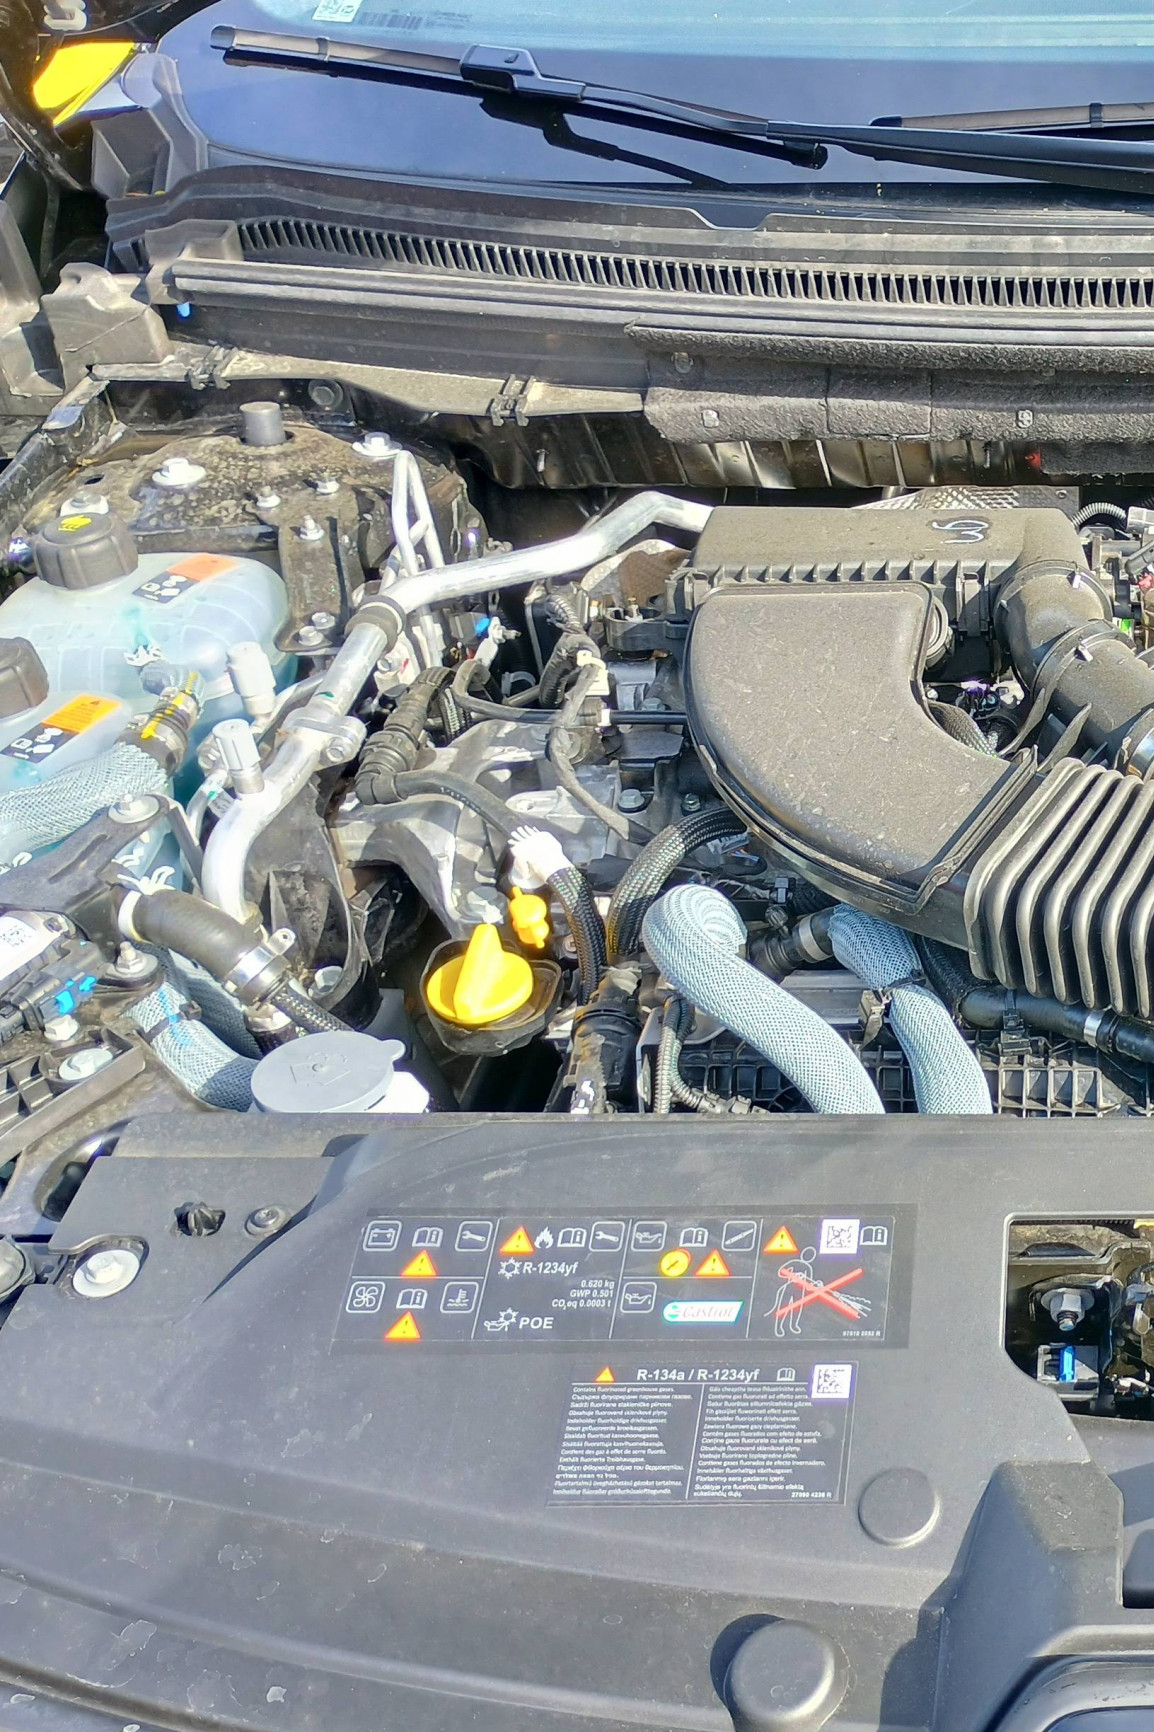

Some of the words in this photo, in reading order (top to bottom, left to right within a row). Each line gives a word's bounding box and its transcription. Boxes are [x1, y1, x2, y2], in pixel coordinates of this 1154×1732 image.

[522, 1261, 579, 1277] R-1234yf
[581, 1279, 603, 1288] 0.620
[604, 1279, 615, 1290] kg
[570, 1289, 591, 1298] GWP
[592, 1289, 614, 1298] 0.501
[579, 1299, 606, 1307] 0.0003
[519, 1316, 554, 1329] POE
[636, 1368, 686, 1381] R-134a
[688, 1368, 695, 1381] /
[697, 1368, 760, 1384] R-1234yf
